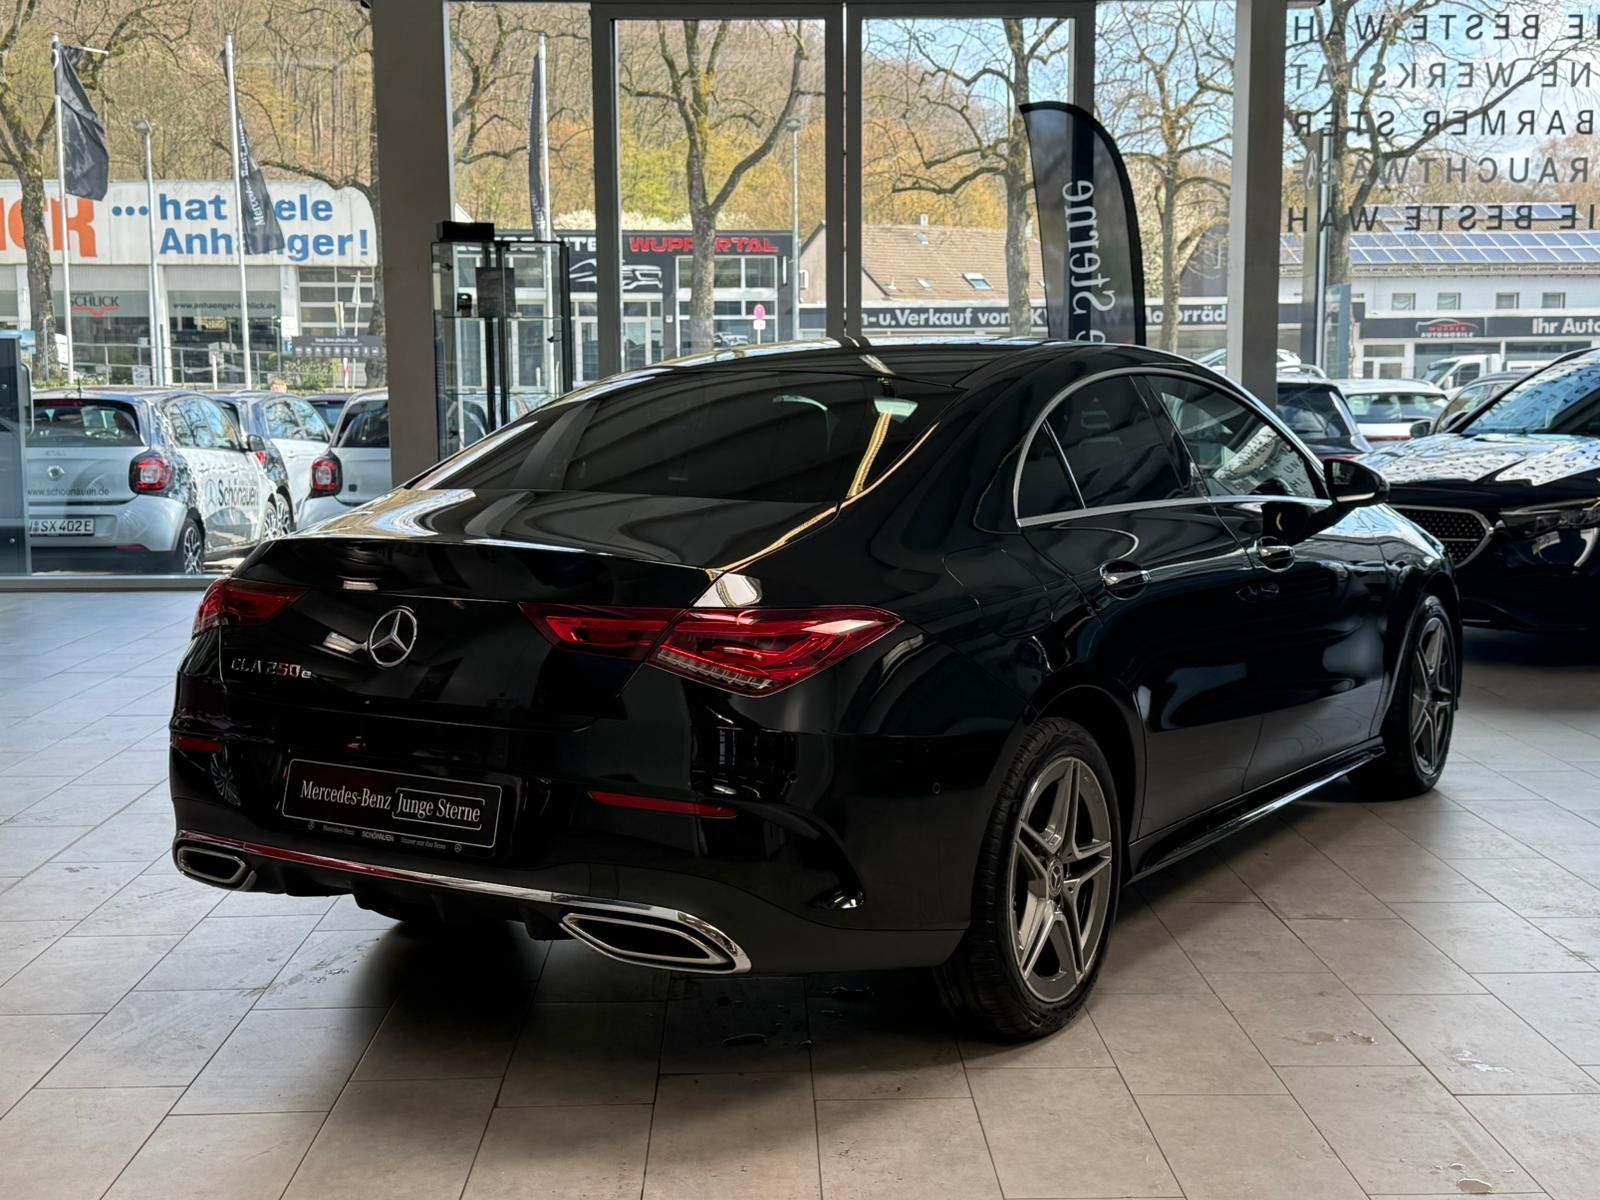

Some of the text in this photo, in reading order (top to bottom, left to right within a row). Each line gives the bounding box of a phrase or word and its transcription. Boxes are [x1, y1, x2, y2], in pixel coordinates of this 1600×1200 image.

[1532, 318, 1557, 334] Ihr
[231, 657, 262, 673] CLA
[300, 779, 481, 823] Mercedes-Benz Junge Sterne
